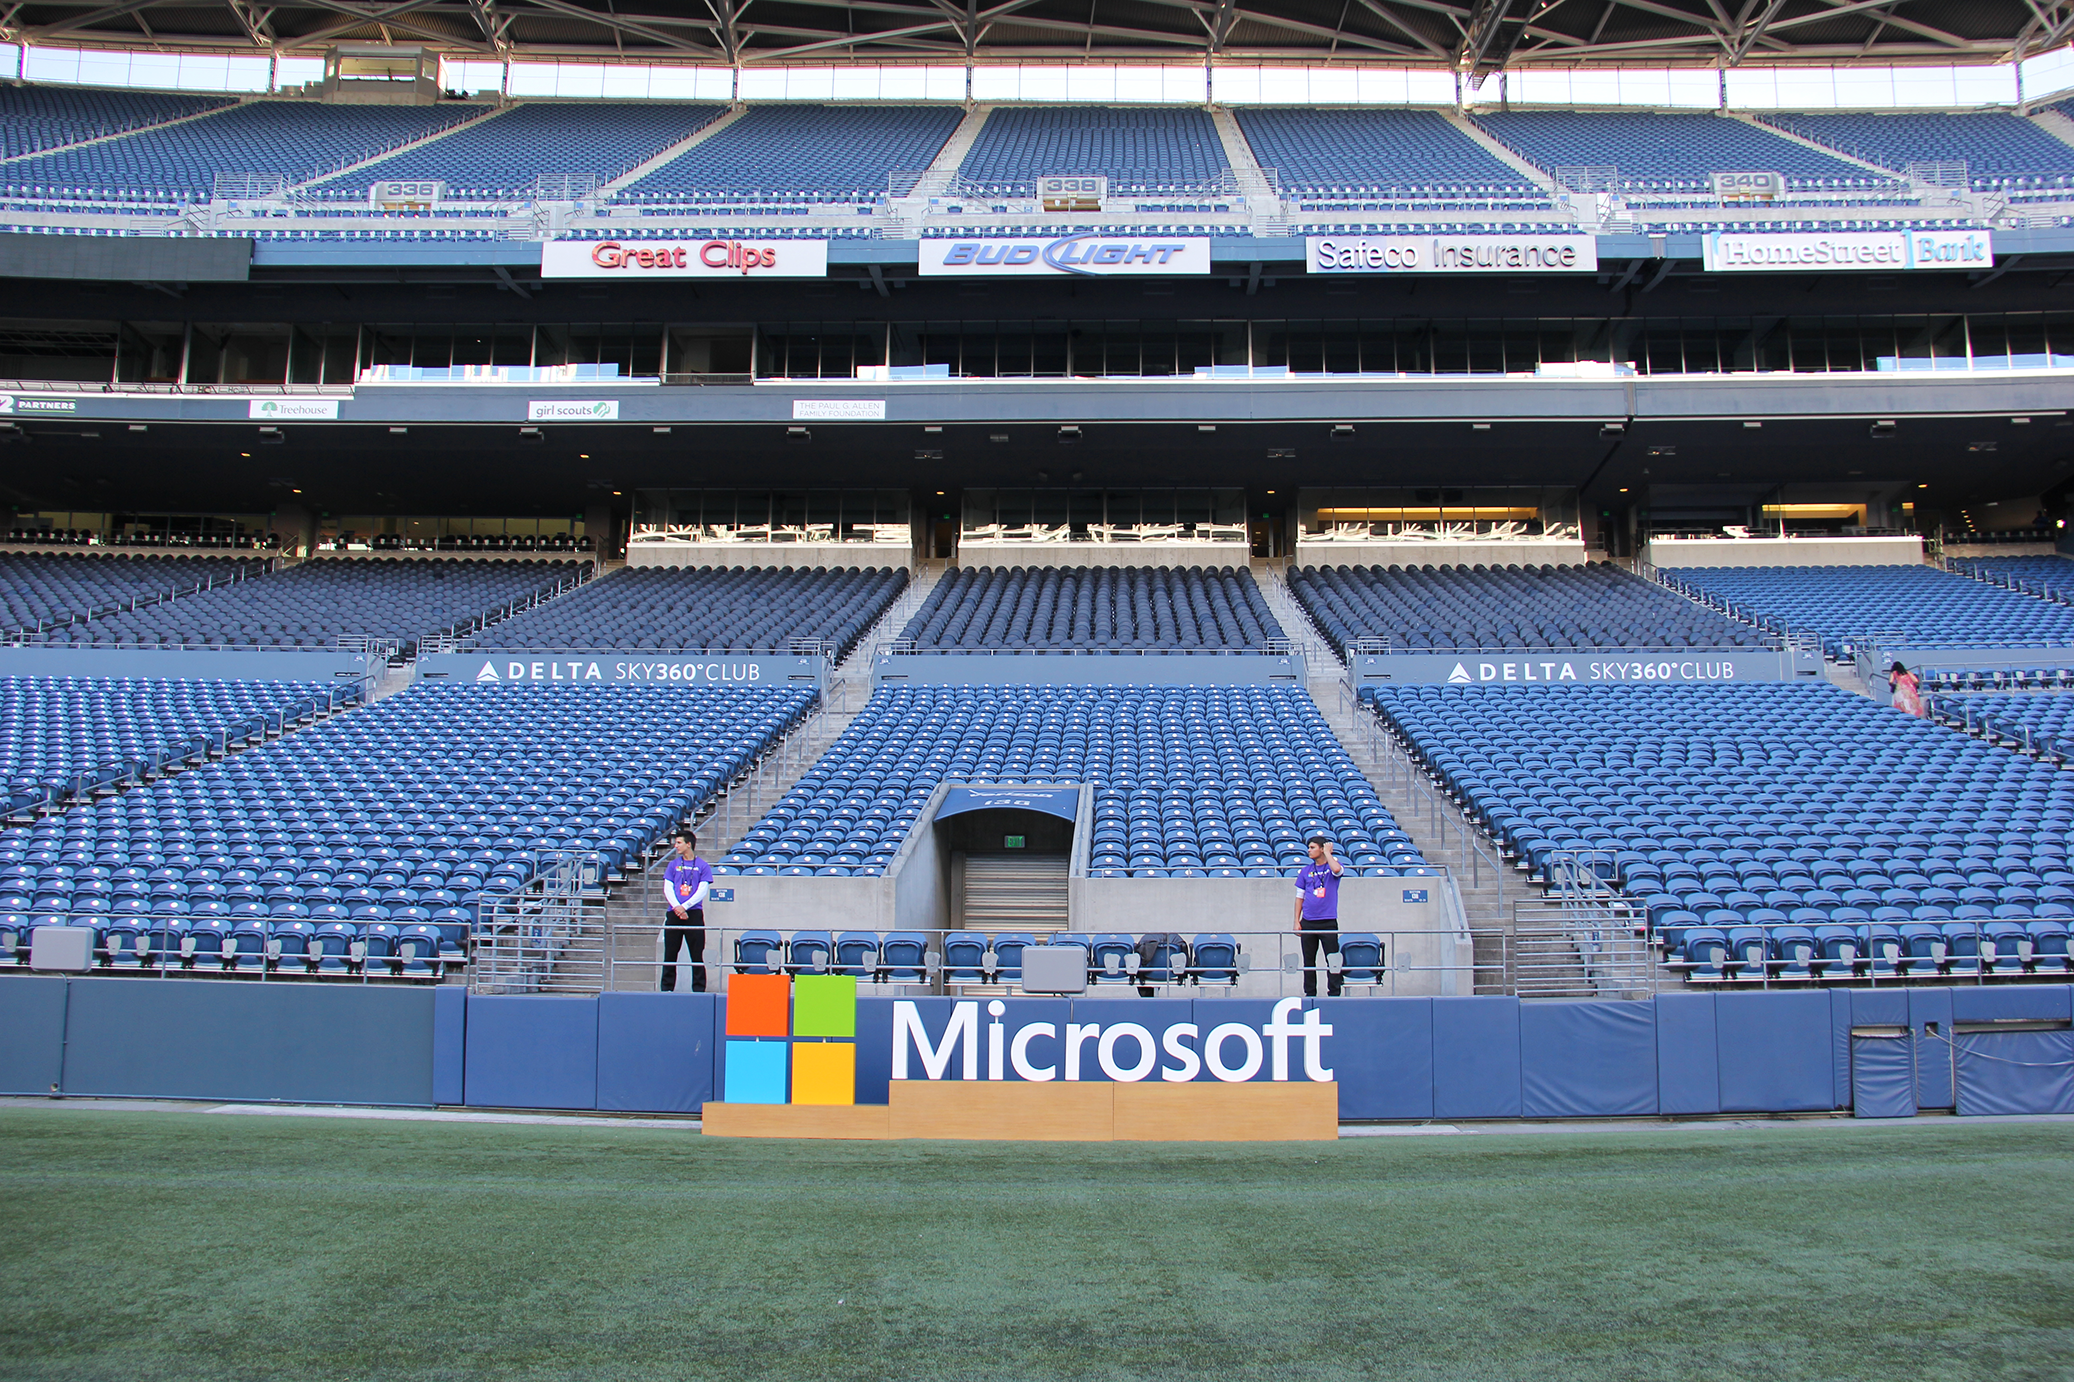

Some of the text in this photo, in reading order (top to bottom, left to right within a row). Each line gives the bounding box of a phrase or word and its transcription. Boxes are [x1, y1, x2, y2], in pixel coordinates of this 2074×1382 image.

[1047, 179, 1097, 192] 338
[1720, 174, 1770, 188] 340
[387, 183, 434, 196] 336
[1318, 238, 1578, 269] Safeco Insurance
[1725, 235, 1986, 265] HomeStreet Bank
[591, 240, 777, 275] Great Clips
[18, 400, 77, 410] PARTNERS
[279, 404, 328, 415] Treehouse
[536, 404, 593, 418] girl scouts
[800, 402, 817, 410] THE
[818, 402, 840, 410] PAUL
[852, 402, 880, 410] ALLEN
[508, 661, 602, 680] DELTA
[1479, 662, 1577, 681] DELTA
[891, 996, 1335, 1082] Microsoft
